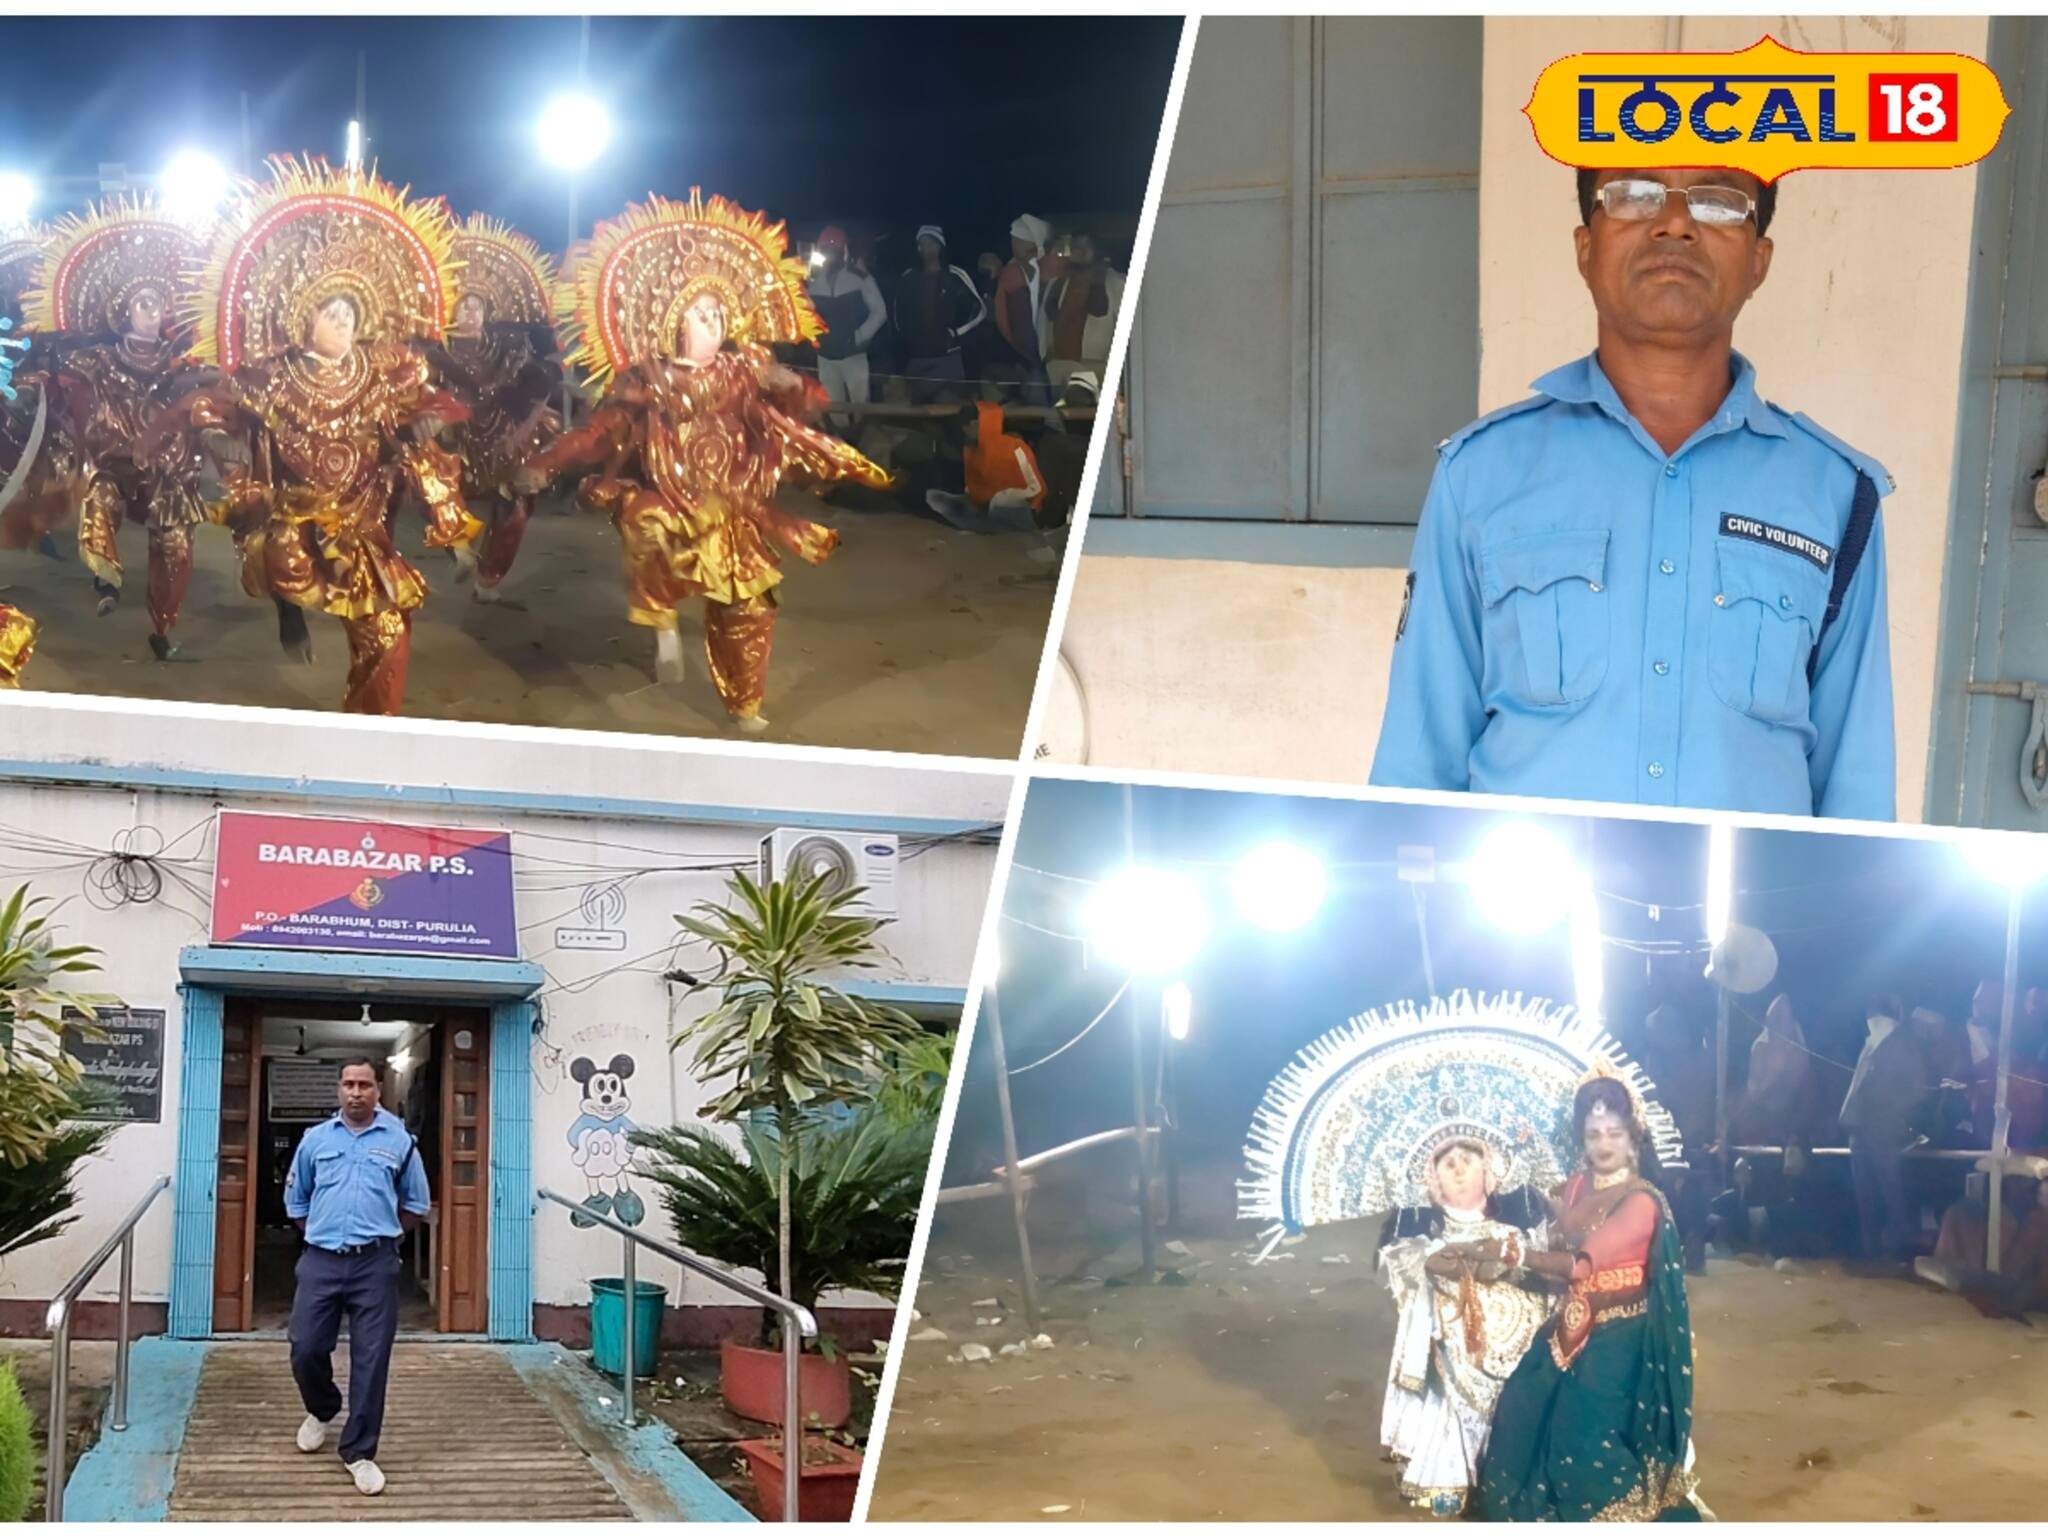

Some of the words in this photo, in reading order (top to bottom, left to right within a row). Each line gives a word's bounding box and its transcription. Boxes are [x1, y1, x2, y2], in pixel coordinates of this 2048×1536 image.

[1727, 517, 1762, 536] CIVIC
[1765, 526, 1829, 564] VOLUNTEER
[258, 843, 422, 873] BARABAZAR
[429, 855, 474, 875] P.S.
[289, 913, 375, 928] BARABHUM,
[378, 919, 413, 930] DIST-
[416, 921, 477, 934] PURULIA
